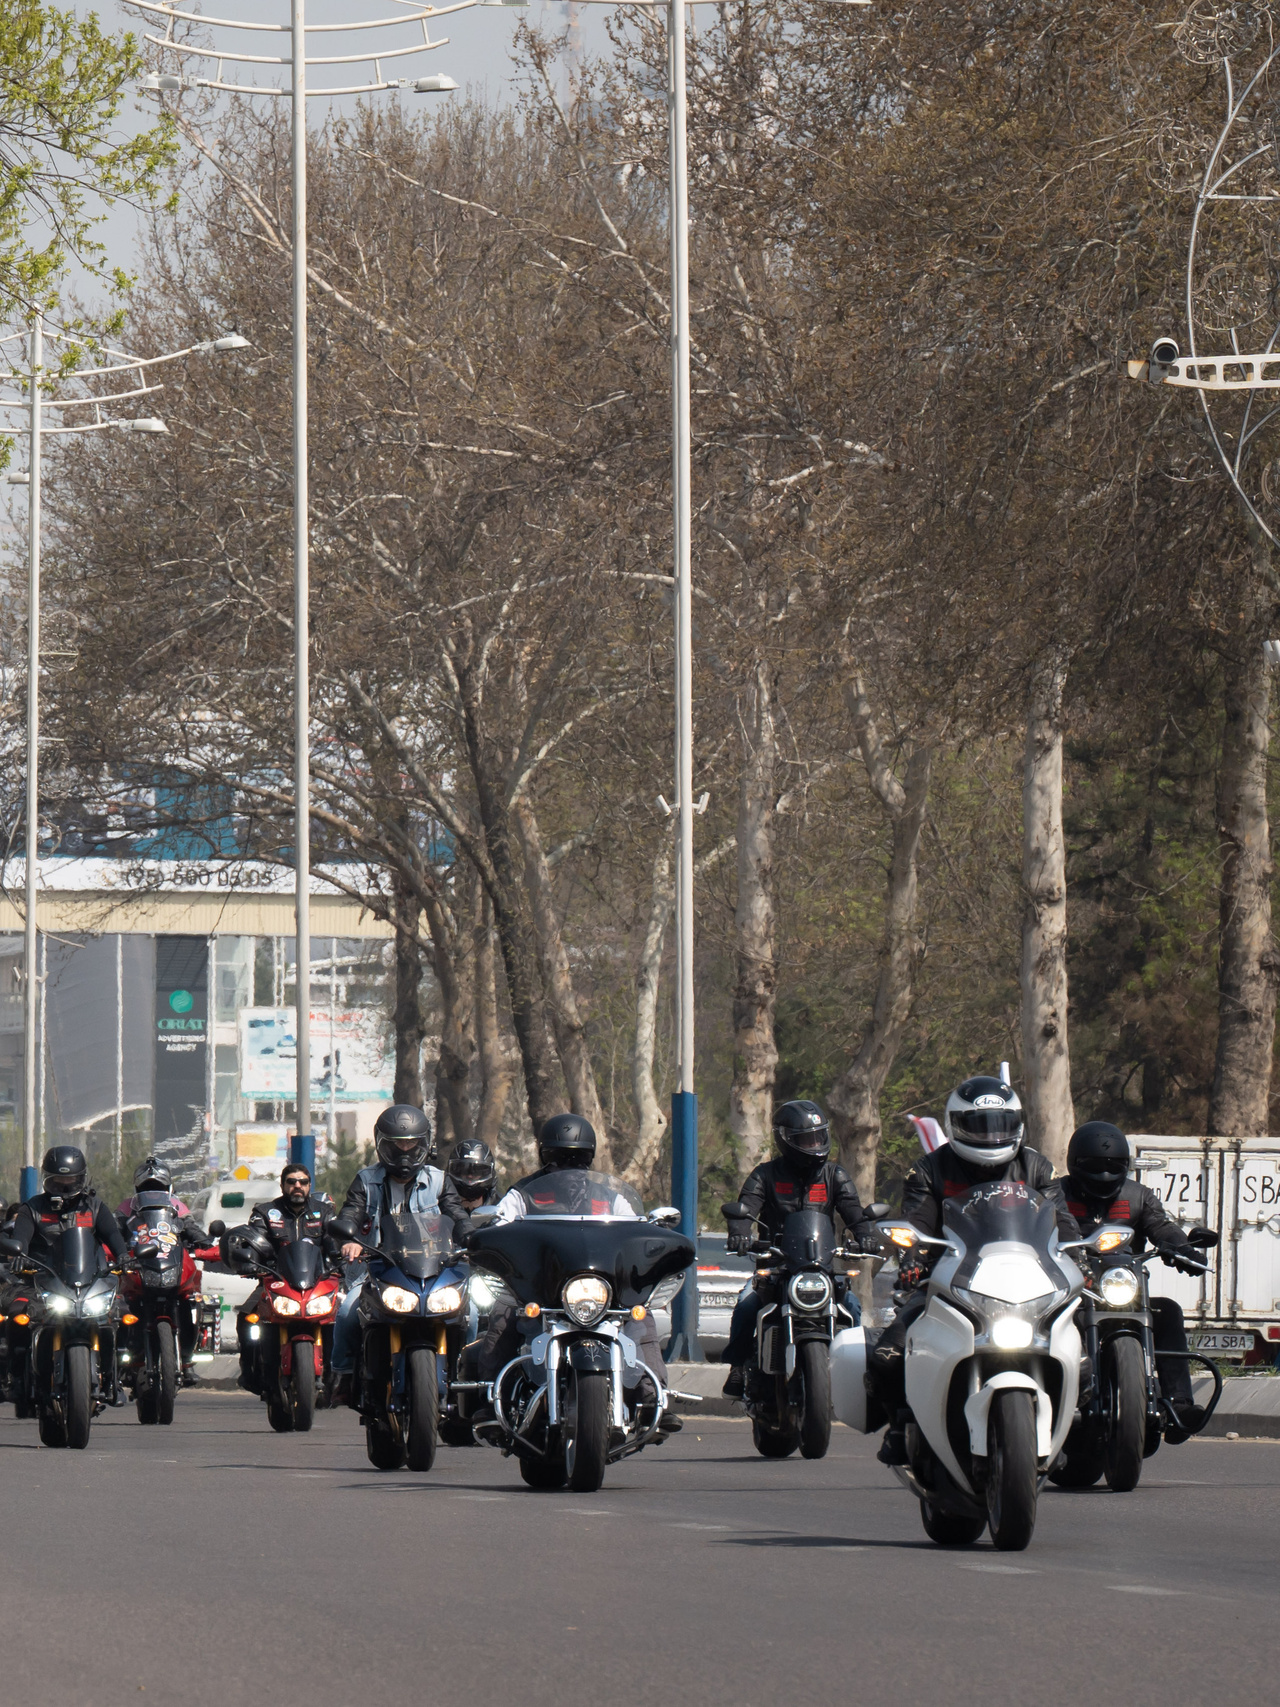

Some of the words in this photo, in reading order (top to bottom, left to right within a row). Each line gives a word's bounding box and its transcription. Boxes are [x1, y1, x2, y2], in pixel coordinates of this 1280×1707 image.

[1164, 1173, 1206, 1202] 721
[1196, 1335, 1218, 1348] 721
[1221, 1335, 1246, 1349] SBA
